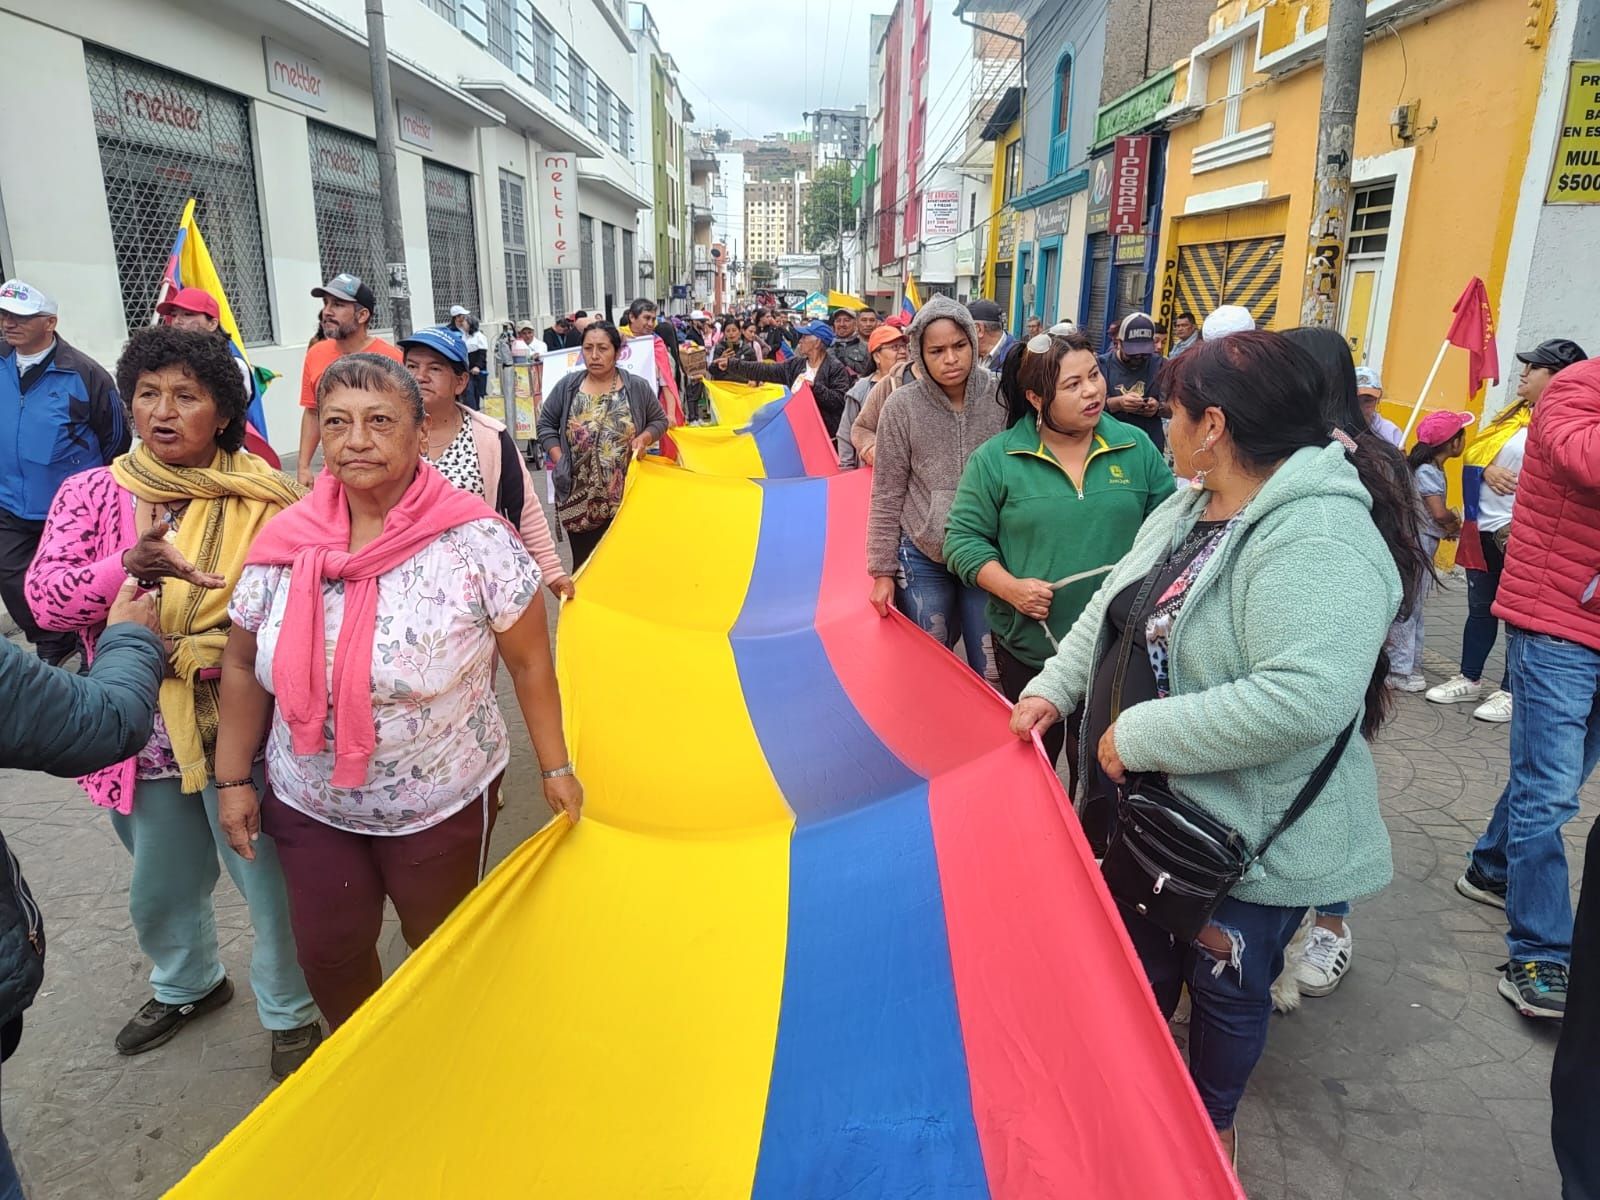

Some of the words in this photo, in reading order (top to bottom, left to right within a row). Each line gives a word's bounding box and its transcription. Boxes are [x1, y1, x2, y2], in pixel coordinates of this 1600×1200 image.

[274, 61, 321, 97] mettler
[1563, 126, 1581, 137] EN
[544, 157, 568, 264] mettler
[1115, 138, 1142, 233] TIPOGRAFIA
